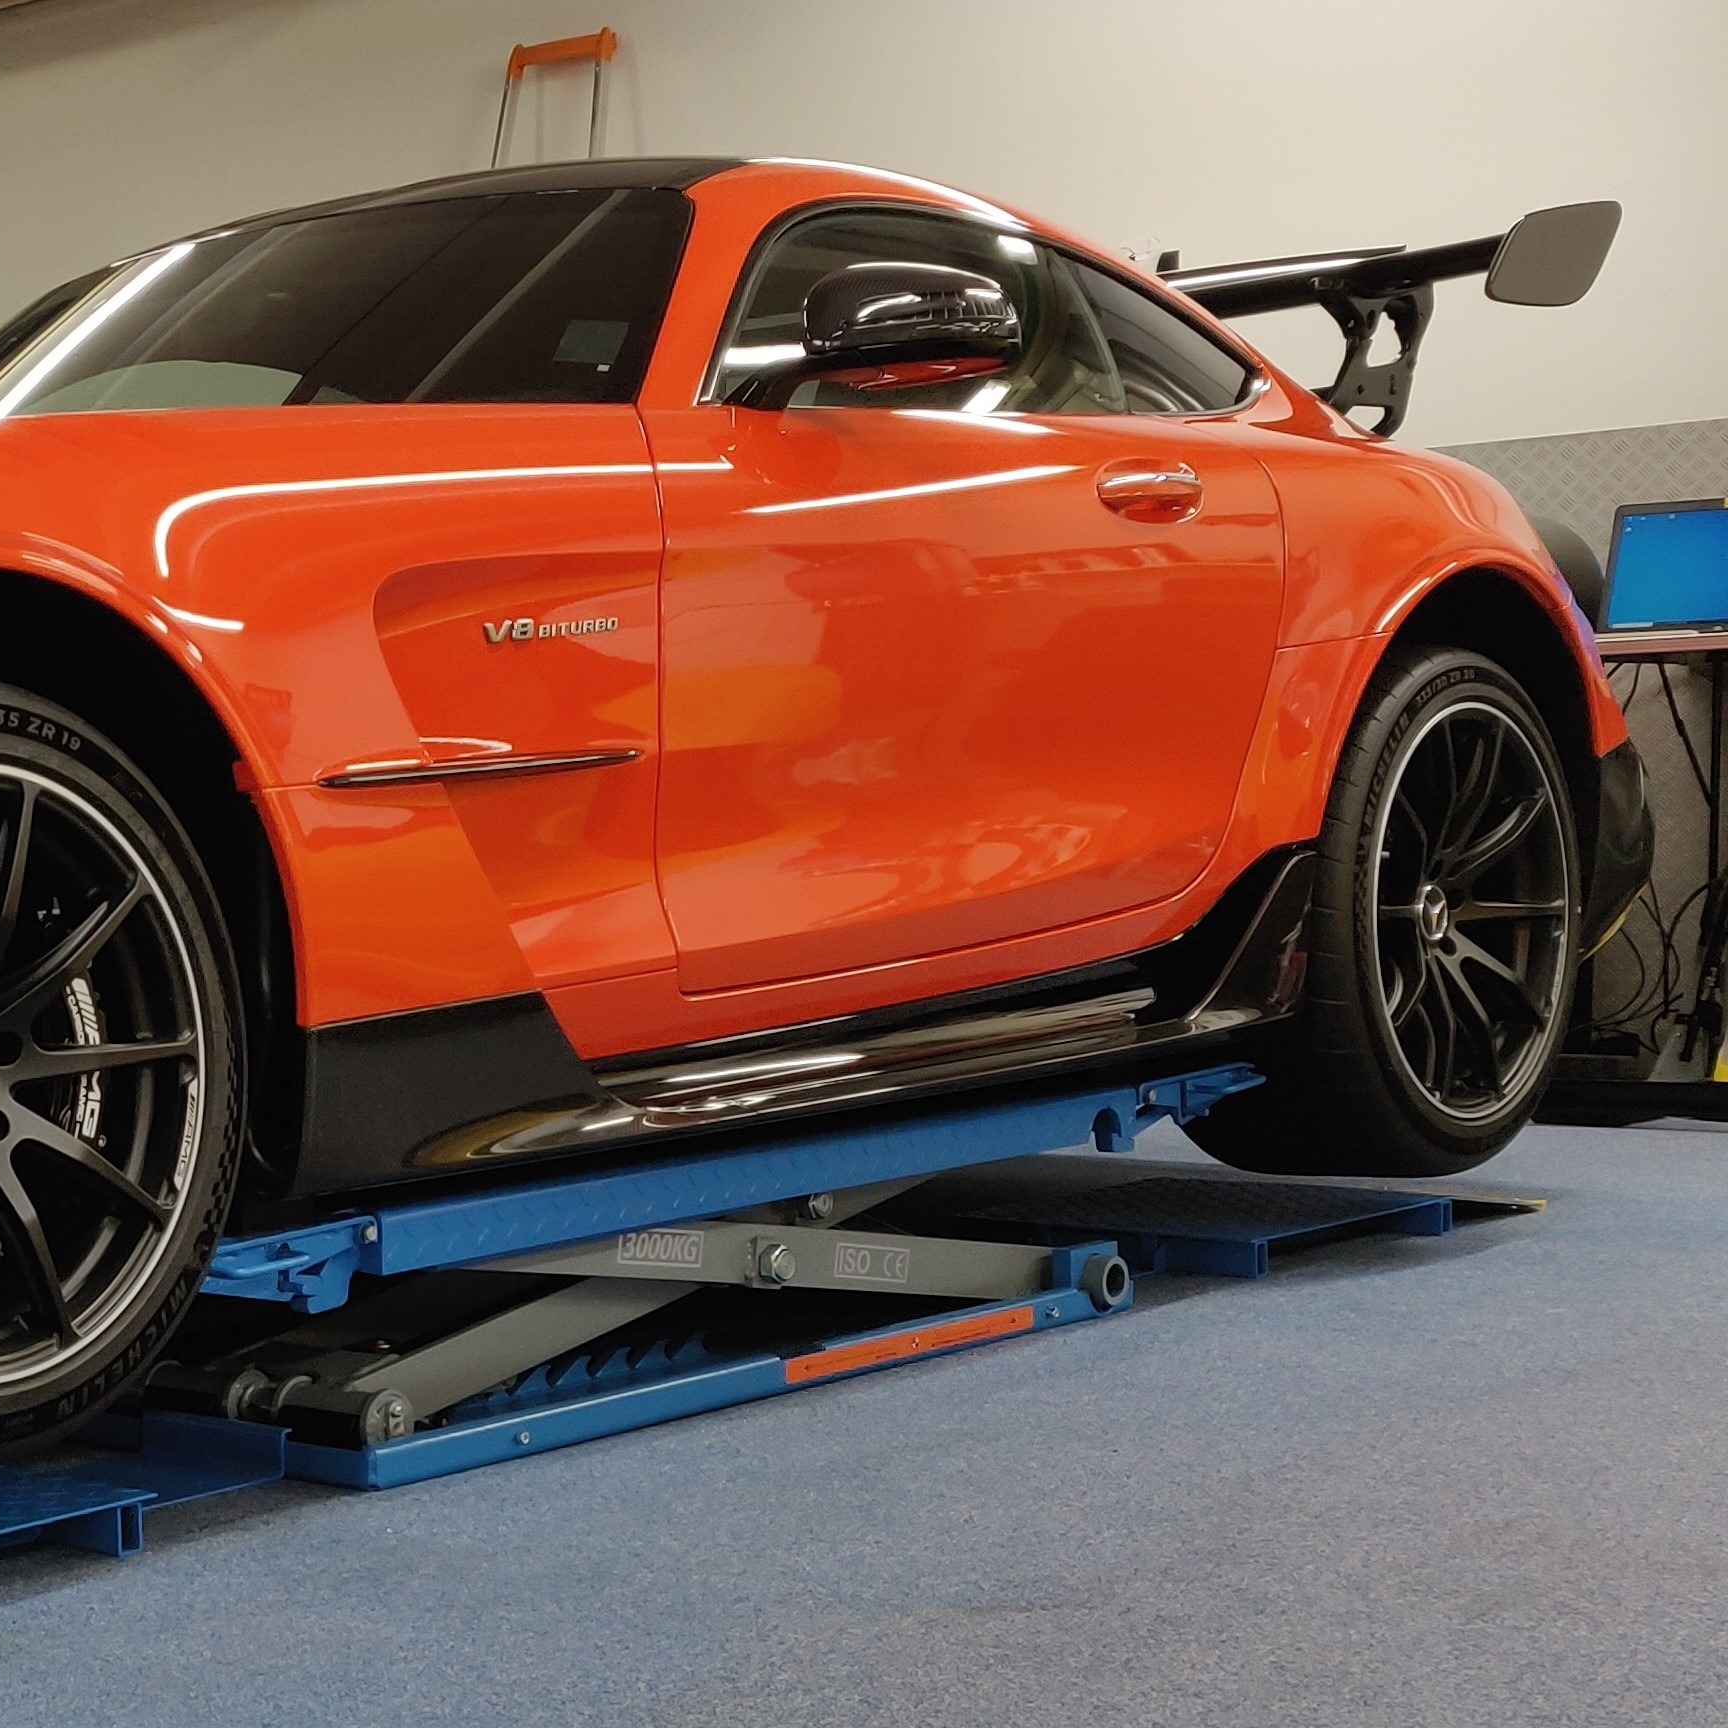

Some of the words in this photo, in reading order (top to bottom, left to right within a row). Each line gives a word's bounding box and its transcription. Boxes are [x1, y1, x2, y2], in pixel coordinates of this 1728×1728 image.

[482, 617, 534, 644] V8
[538, 616, 620, 640] BITURBO
[26, 716, 57, 741] ZR
[61, 730, 82, 752] 19
[622, 1232, 699, 1261] 3000KG
[838, 1250, 871, 1275] ISO
